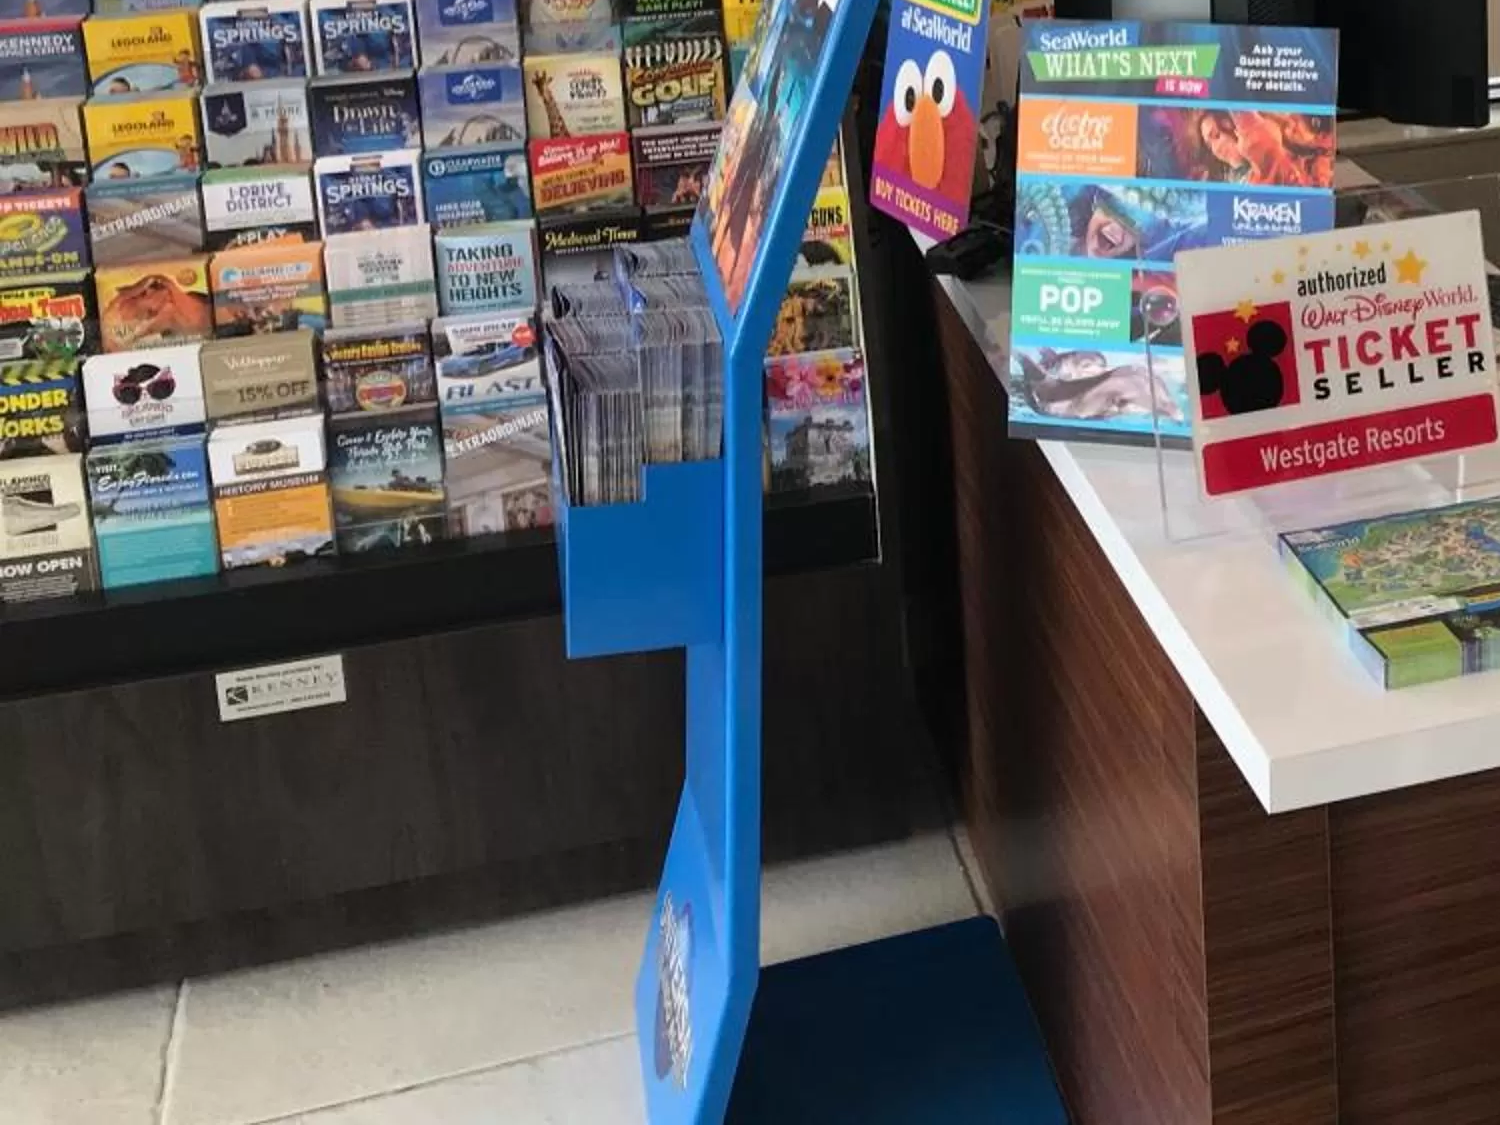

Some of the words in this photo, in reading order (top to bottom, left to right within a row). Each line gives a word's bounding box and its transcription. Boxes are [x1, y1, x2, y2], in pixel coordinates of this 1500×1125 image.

[213, 23, 298, 49] SPRINGS
[323, 15, 405, 40] SPRINGS
[912, 9, 973, 53] SeaWorld
[0, 33, 74, 49] KENNEDY
[111, 34, 173, 49] LEGOLAND
[1040, 28, 1128, 51] SeaWorld
[1253, 43, 1273, 55] Ask
[1276, 46, 1302, 57] your
[1043, 50, 1132, 78] WHAT'S
[1140, 50, 1197, 77] NEXT
[1273, 56, 1315, 68] Service
[1234, 66, 1319, 81] Representative
[1246, 77, 1263, 90] for
[631, 71, 717, 108] GOLF
[1164, 78, 1175, 91] IS
[1178, 79, 1203, 94] NOW
[1048, 135, 1104, 150] OCEAN
[228, 182, 285, 199] I-DRIVE
[325, 177, 410, 204] SPRINGS
[15, 196, 72, 211] TICKETS
[225, 194, 293, 213] DISTRICT
[875, 177, 892, 201] BUY
[894, 185, 932, 222] TICKETS
[933, 205, 961, 236] HERE
[1233, 195, 1301, 224] KRAKEN
[811, 206, 843, 227] GUNS
[544, 229, 601, 251] Medieval
[445, 242, 514, 262] TAKING
[447, 256, 524, 273] ADVENTURE
[449, 273, 471, 288] TO
[475, 270, 516, 286] NEW
[1297, 262, 1387, 297] authorized
[449, 282, 523, 303] HEIGHTS
[1039, 284, 1103, 313] POP
[1304, 313, 1481, 375] TICKET
[1313, 351, 1486, 401] SELLER
[237, 384, 273, 403] 15%
[276, 380, 310, 397] OFF
[1260, 431, 1360, 473] Westgate
[1366, 416, 1446, 453] Resorts
[219, 482, 267, 496] HISTORY
[270, 475, 320, 489] MUSEUM
[37, 555, 83, 573] OPEN
